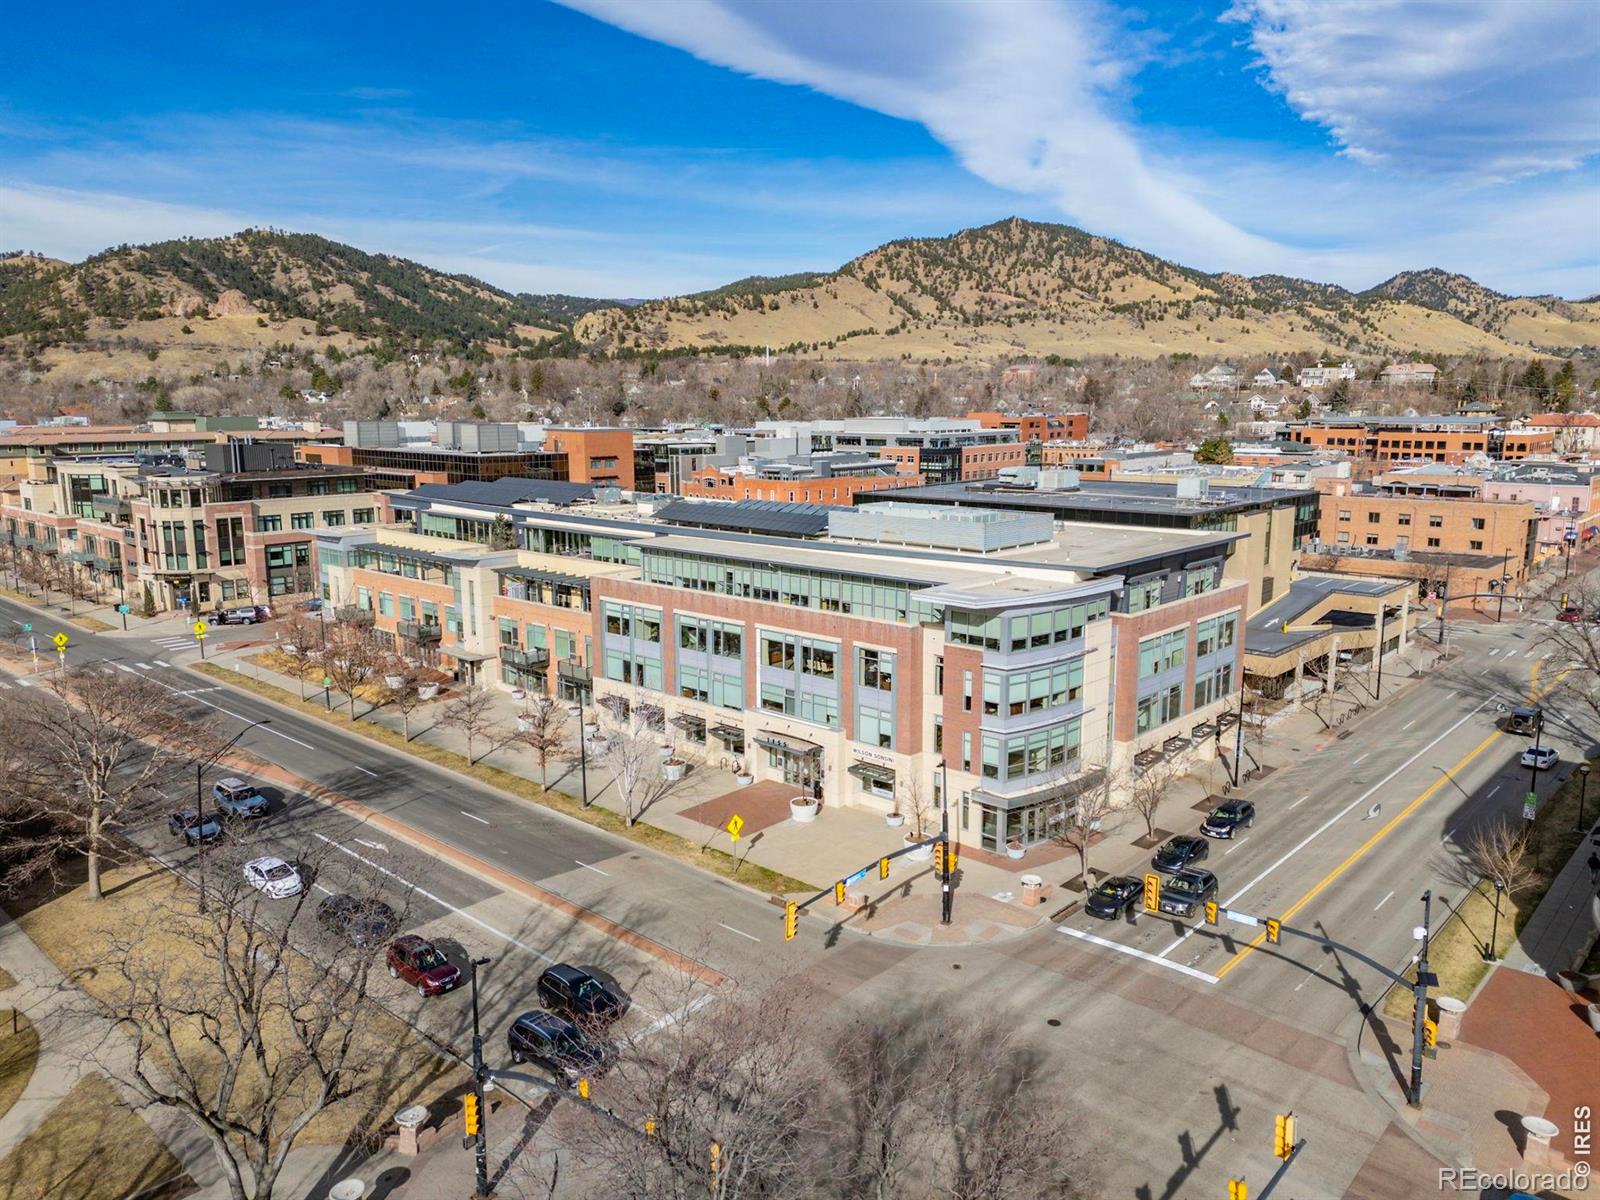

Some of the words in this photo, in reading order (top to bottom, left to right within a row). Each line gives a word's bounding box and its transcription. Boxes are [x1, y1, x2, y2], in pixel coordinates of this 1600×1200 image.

[767, 738, 787, 747] 1155
[853, 748, 872, 757] WILSON
[874, 754, 894, 762] SONSINI
